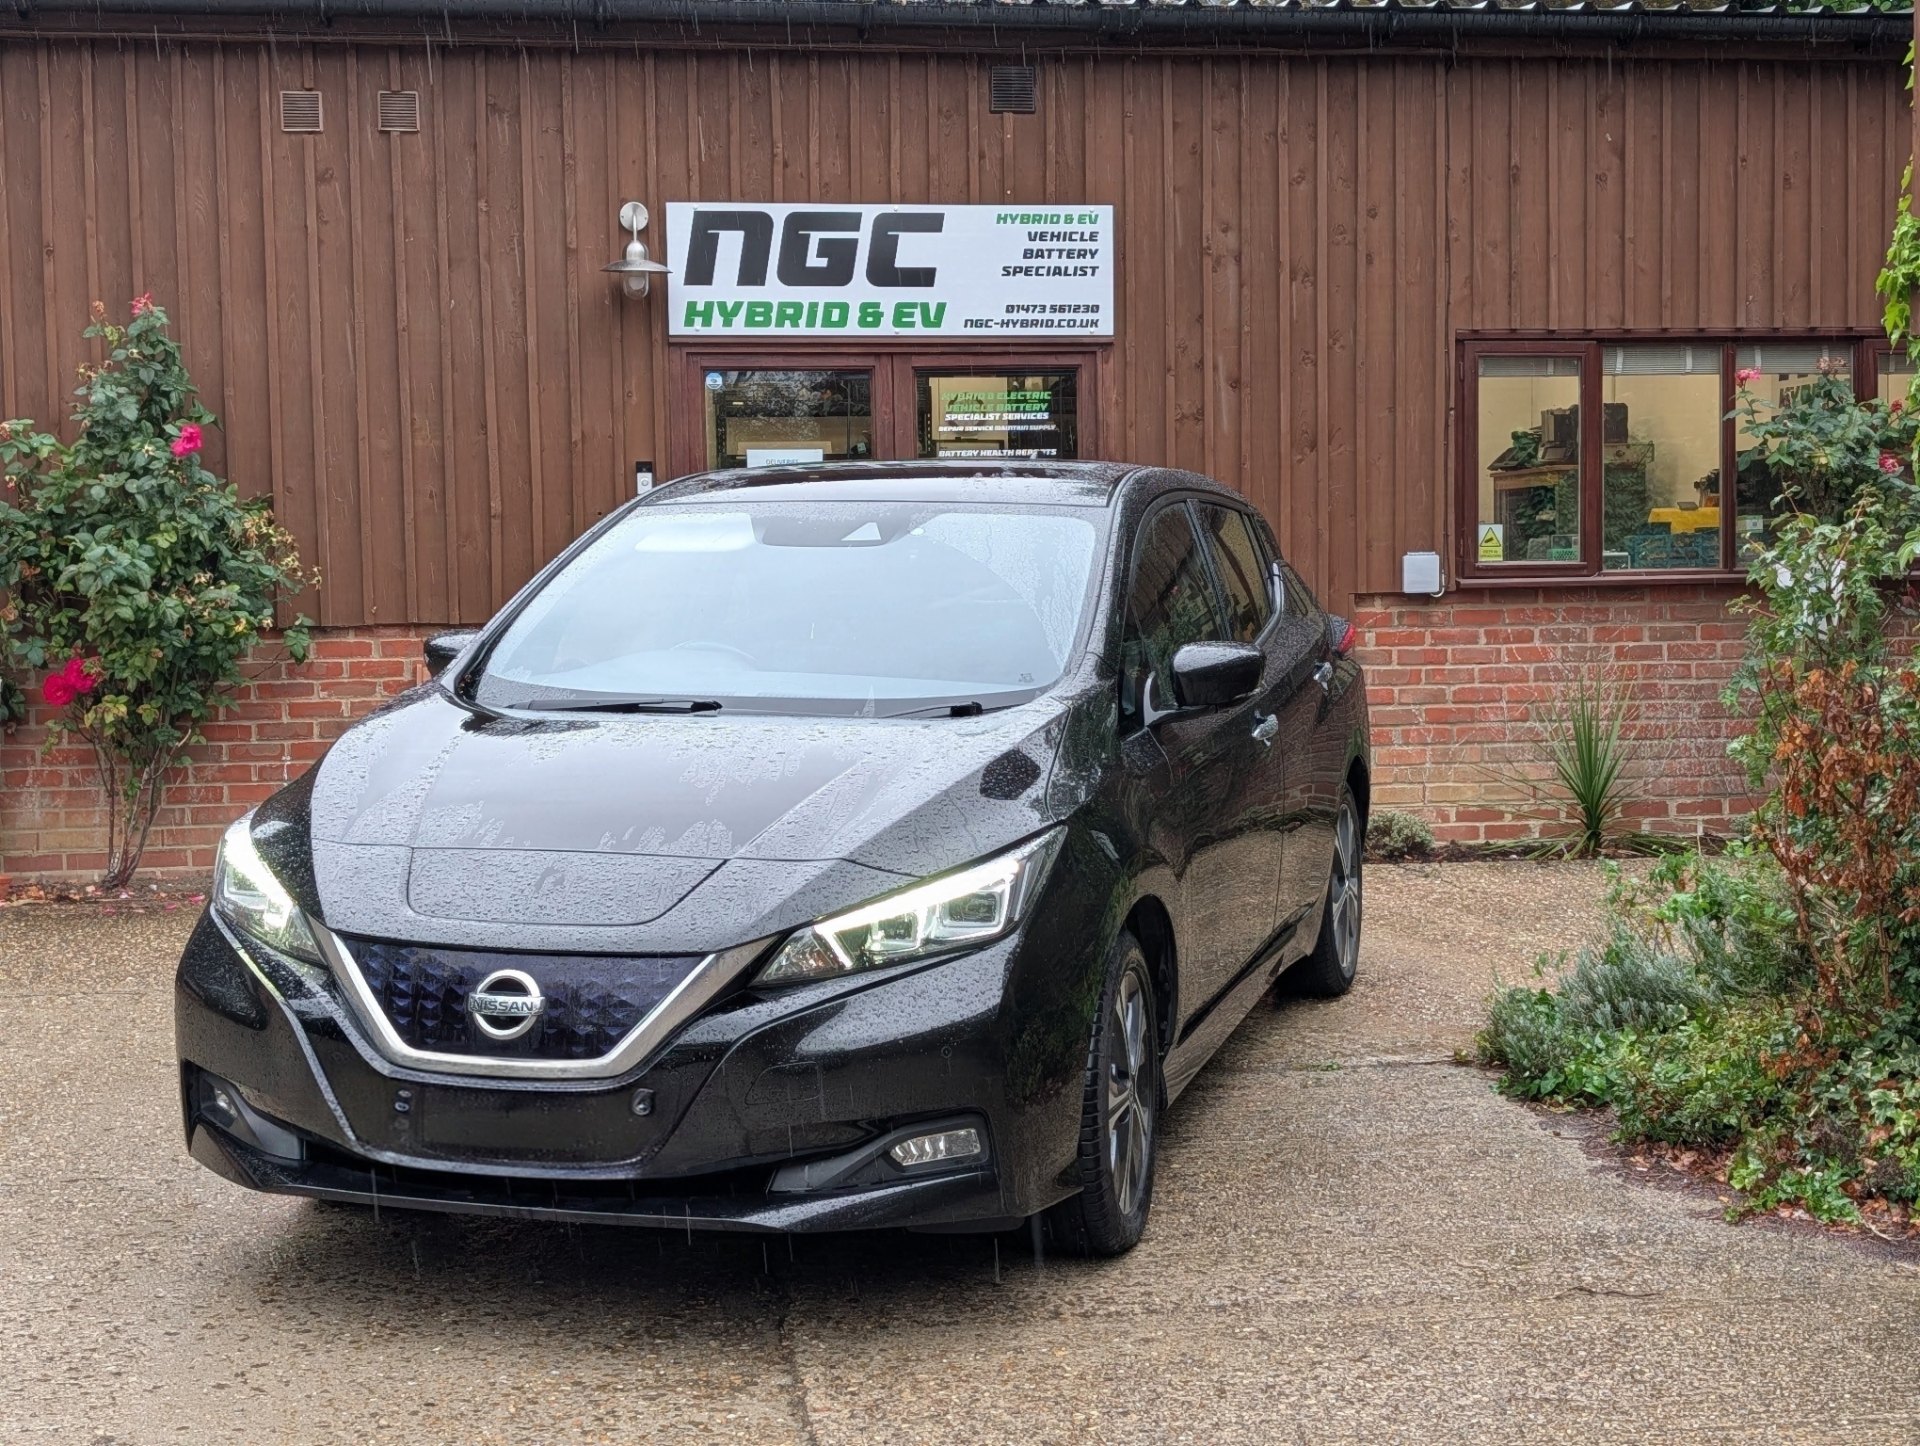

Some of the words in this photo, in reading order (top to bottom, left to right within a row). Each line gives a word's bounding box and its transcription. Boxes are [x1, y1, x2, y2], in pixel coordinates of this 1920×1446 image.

[996, 213, 1061, 224] HYBRID
[1063, 213, 1075, 224] &
[1077, 213, 1099, 224] EV
[1027, 231, 1099, 242] VEHICLE
[683, 210, 945, 287] NGC
[1022, 248, 1099, 259] BATTERY
[1001, 266, 1099, 277] SPECIALIST
[1005, 304, 1047, 314] 01473
[1048, 304, 1100, 314] 561230
[683, 301, 850, 328] HYBRID
[857, 301, 884, 329] &
[892, 302, 947, 329] EV
[963, 318, 1099, 329] NGC-HYBRID.CO.UK
[941, 391, 985, 400] HYBRID
[997, 391, 1052, 400] ELECTRIC
[944, 403, 994, 412] VEHICLE
[996, 402, 1049, 412] BATTERY
[944, 412, 1001, 421] SPECIALIST
[1001, 412, 1050, 420] SERVICES
[938, 449, 980, 457] BATTERY
[979, 449, 1015, 457] HEALTH
[469, 997, 534, 1012] NISSAN
